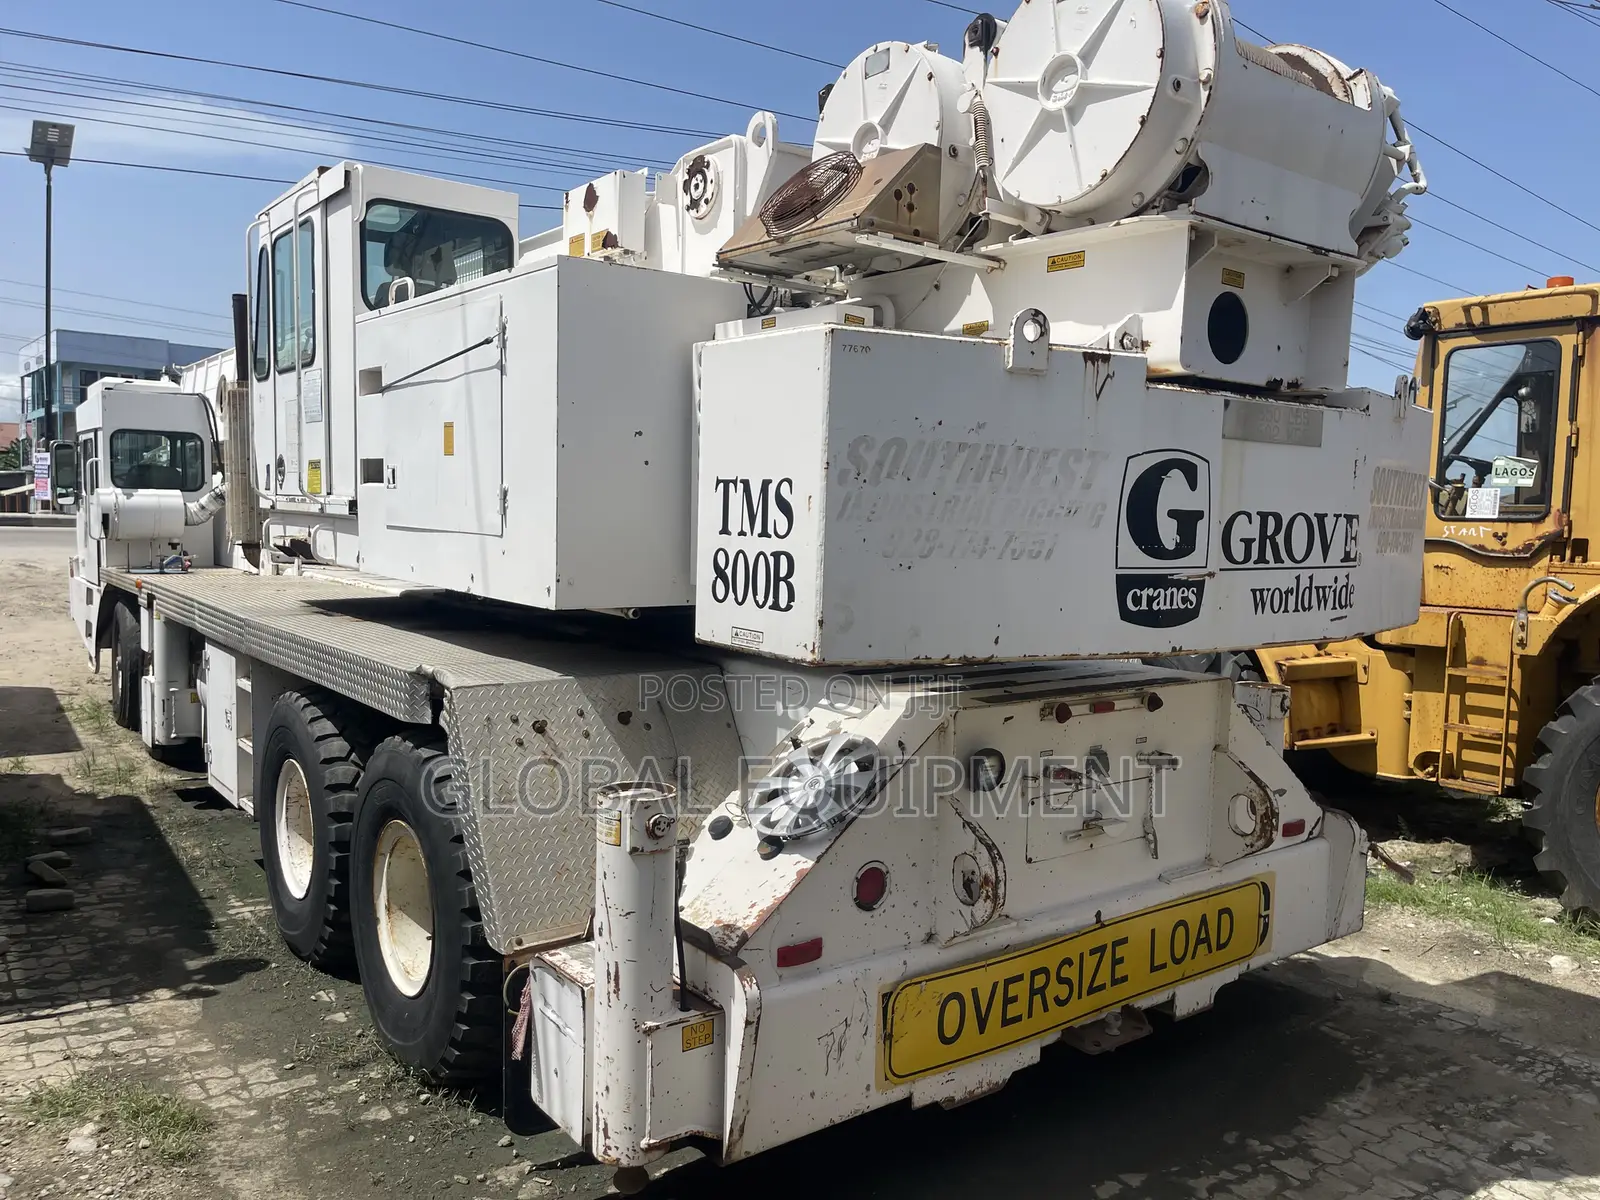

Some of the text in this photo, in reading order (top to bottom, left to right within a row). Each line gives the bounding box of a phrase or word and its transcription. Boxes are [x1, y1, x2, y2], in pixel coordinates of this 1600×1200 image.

[1056, 254, 1082, 263] CAUTION
[837, 434, 1109, 490] SOUTHWEST
[1494, 467, 1535, 477] LAGOS
[715, 476, 794, 539] TMS
[1126, 458, 1205, 561] G
[1221, 511, 1359, 565] GROVE
[1442, 526, 1491, 538] START
[711, 547, 795, 612] 800B
[1250, 572, 1355, 616] worldwide
[1126, 586, 1197, 612] cranes
[740, 630, 761, 640] CAUTION
[937, 906, 1235, 1046] OVERSIZE LOAD
[685, 1033, 710, 1048] STEP
[691, 1023, 706, 1036] NO
